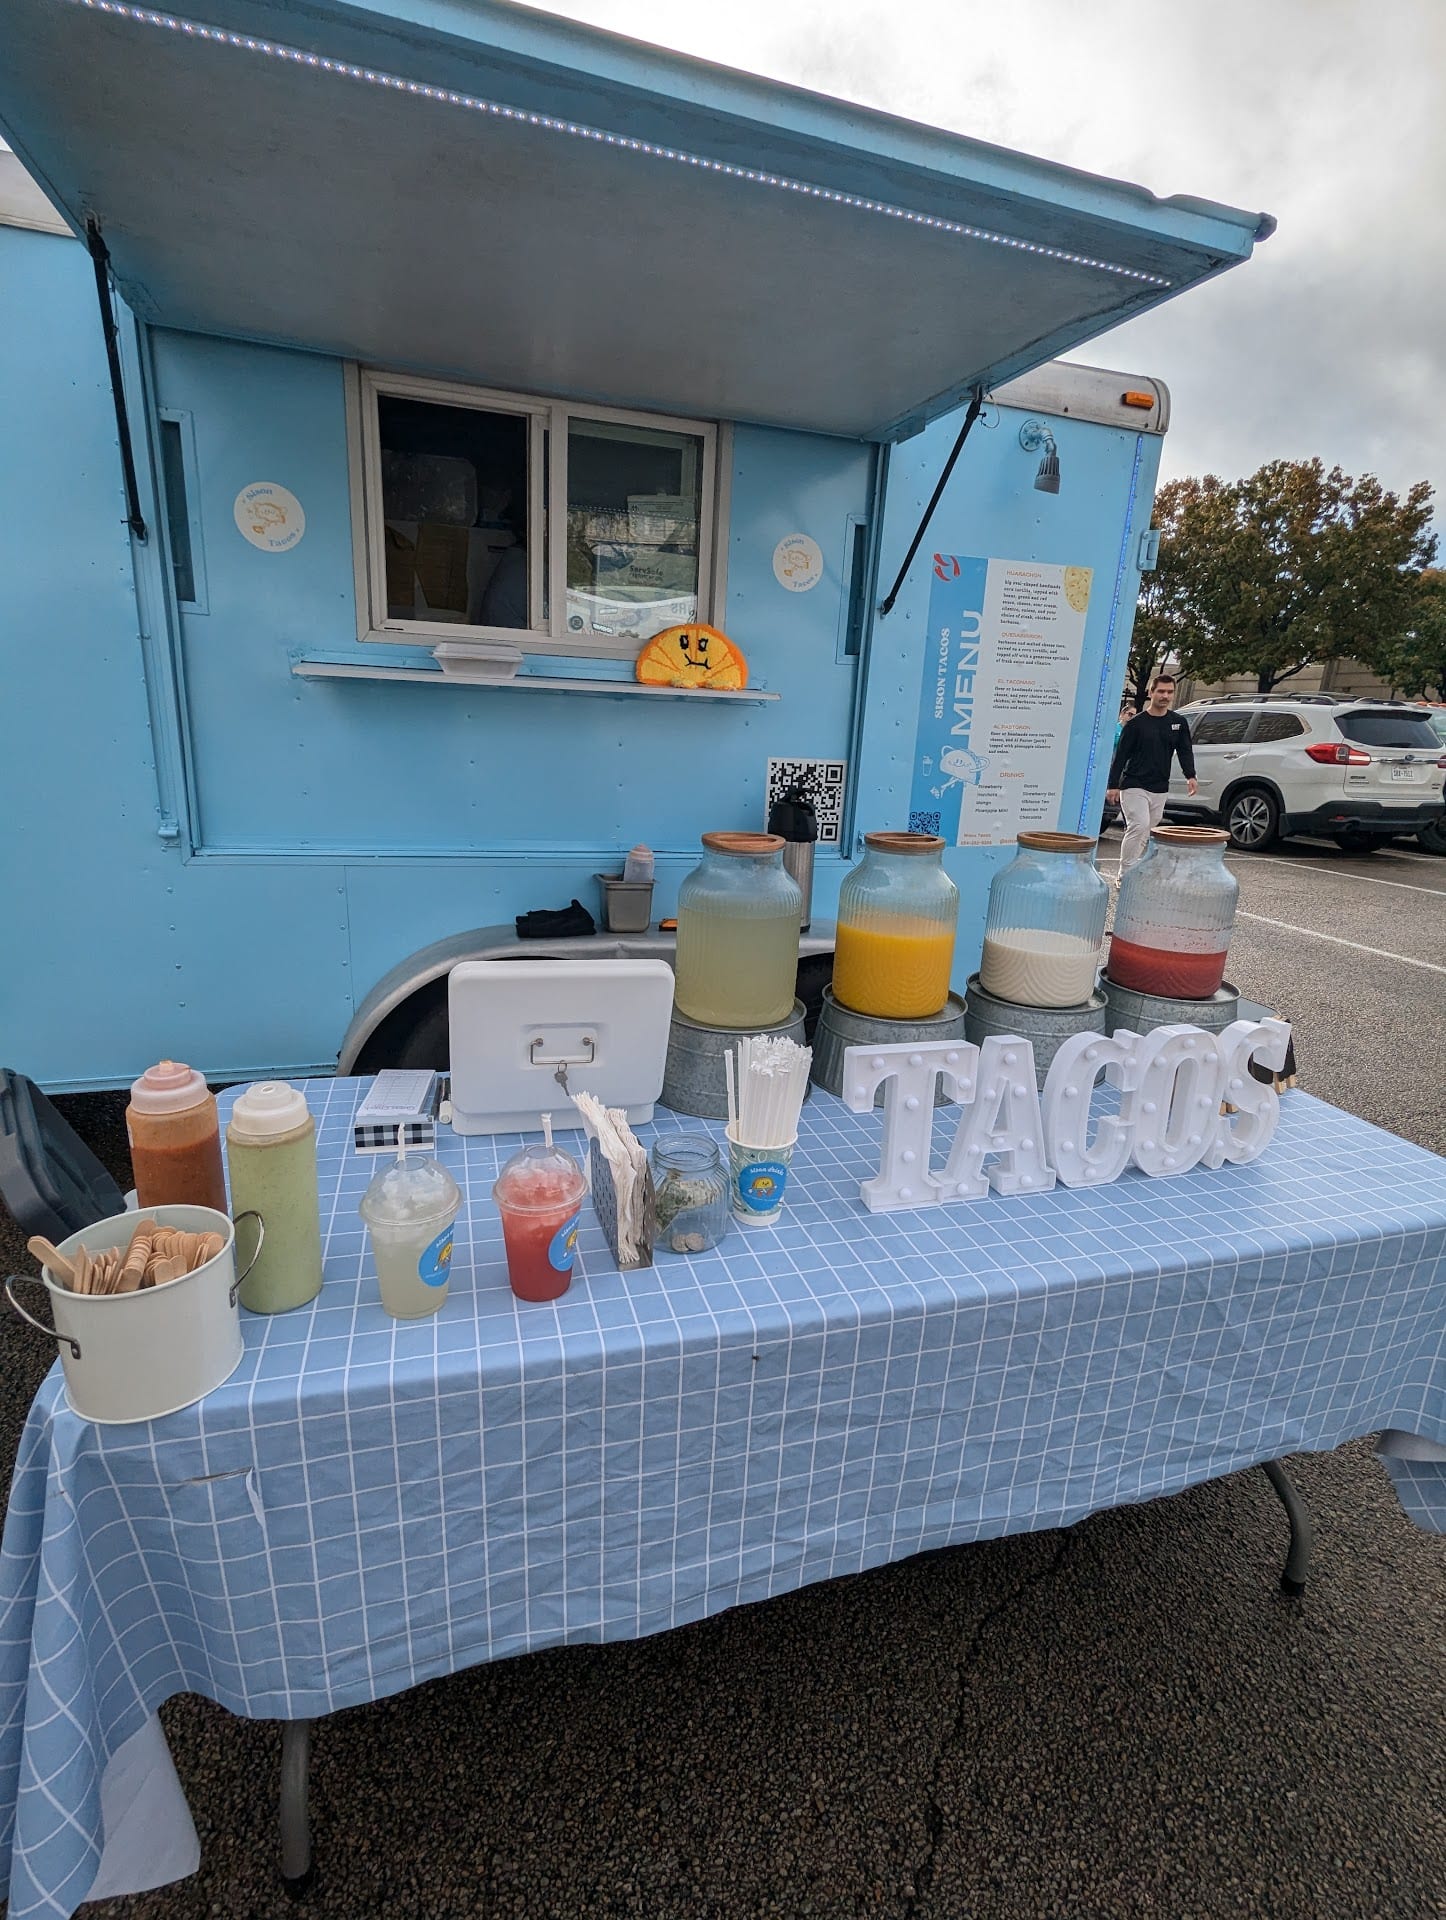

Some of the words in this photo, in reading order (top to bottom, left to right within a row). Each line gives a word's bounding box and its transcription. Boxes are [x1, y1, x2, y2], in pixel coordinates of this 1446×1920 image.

[938, 627, 950, 678] TACOS
[951, 610, 983, 736] MENU
[934, 679, 947, 720] SISON
[843, 1017, 1291, 1213] TACOS
